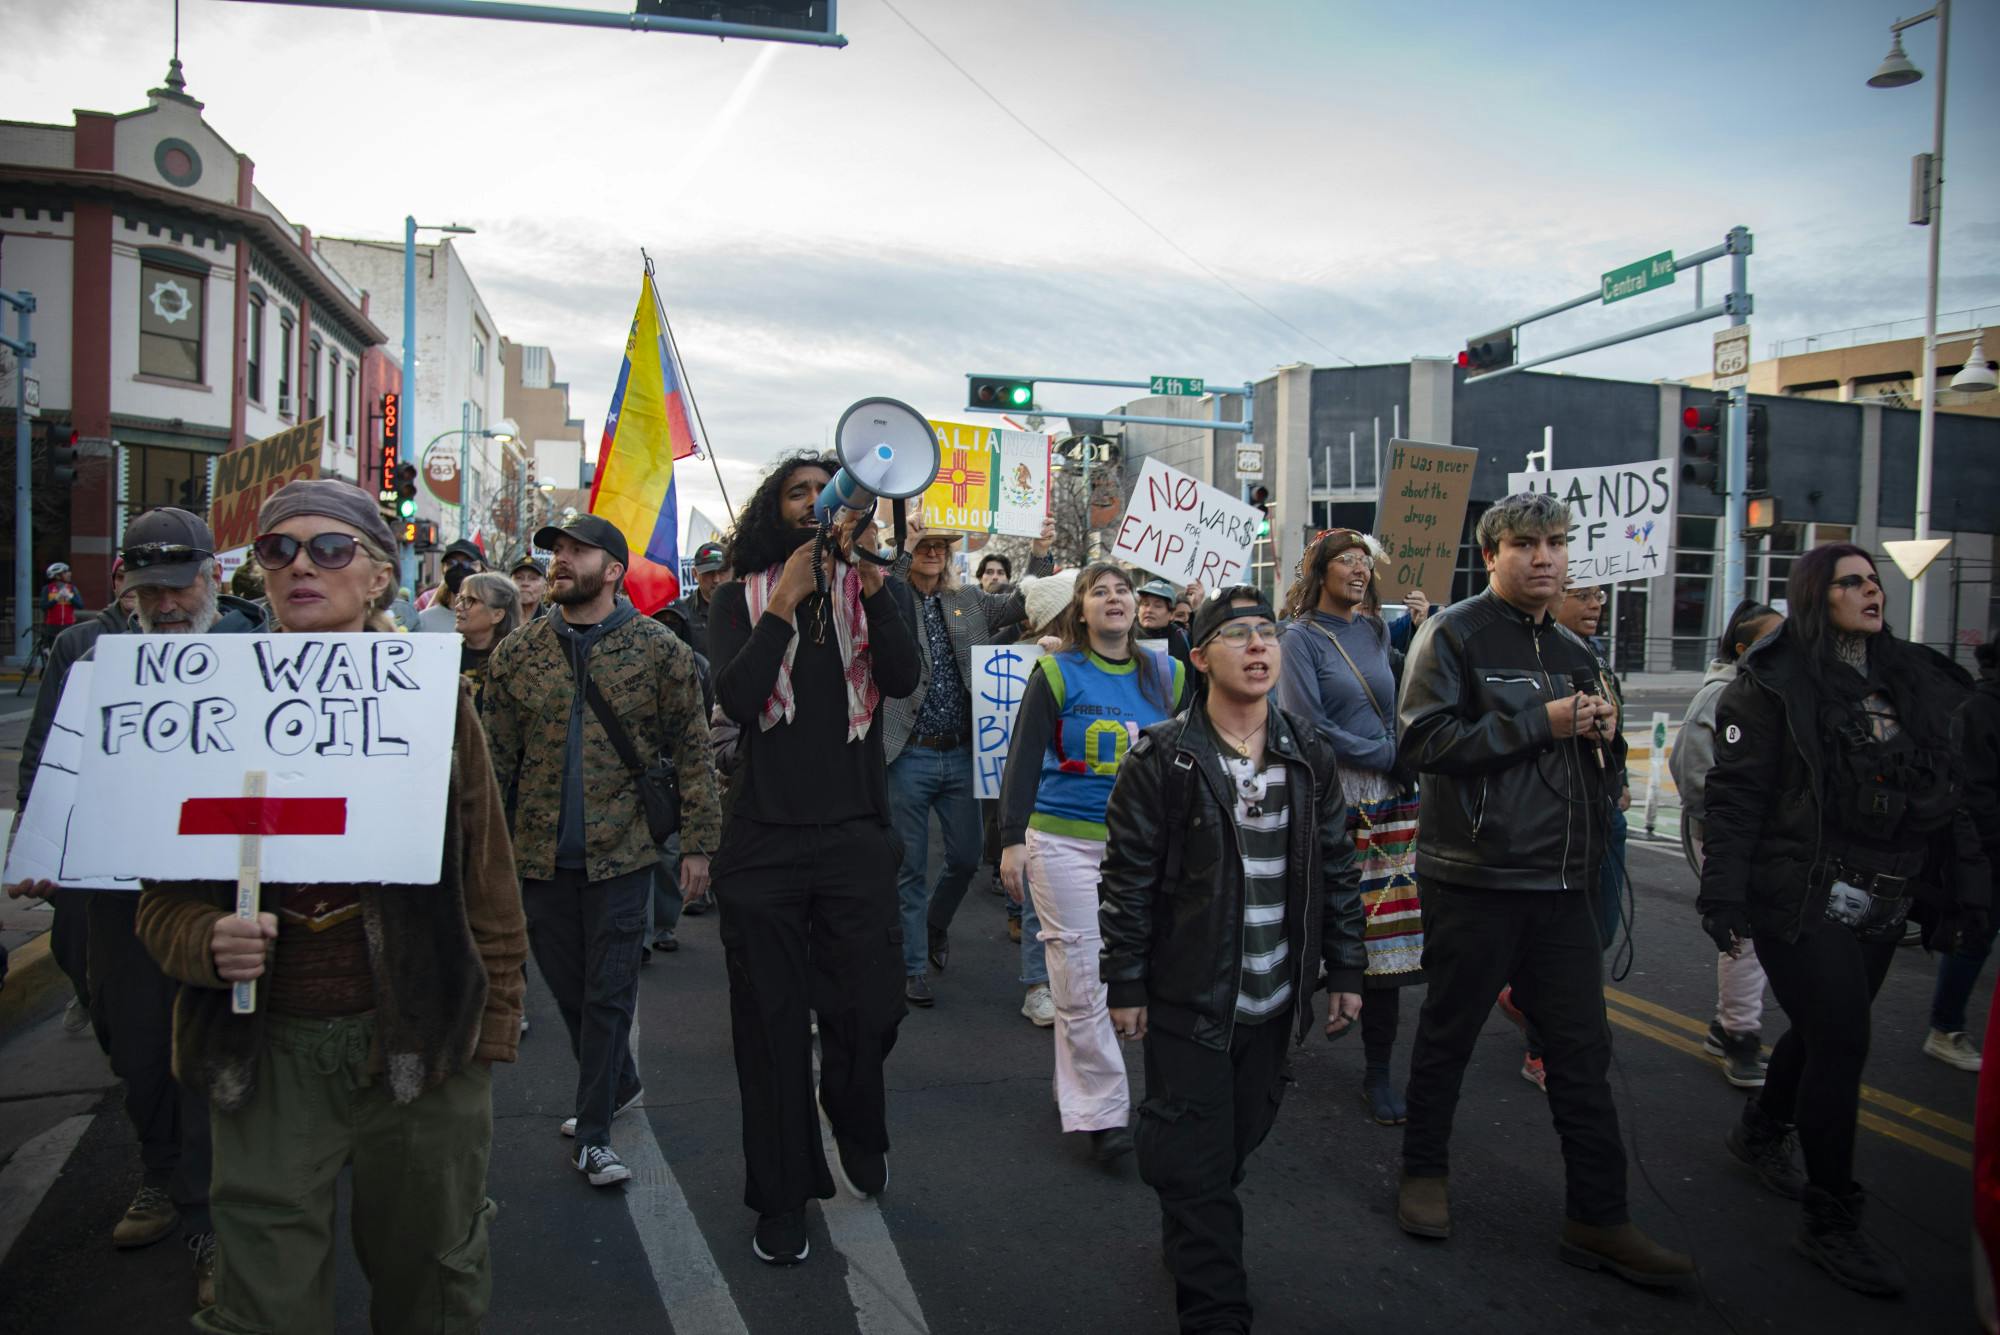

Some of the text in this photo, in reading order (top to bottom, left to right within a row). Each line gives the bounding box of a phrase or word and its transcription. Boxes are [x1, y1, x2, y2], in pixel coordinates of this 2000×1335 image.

[1602, 258, 1673, 300] Central Ave
[1720, 356, 1742, 372] 66
[1152, 379, 1202, 395] 4th St
[384, 395, 396, 488] POOL HALL
[216, 422, 322, 498] NO MORE
[1391, 447, 1469, 474] It was never
[1401, 480, 1448, 499] about the
[1184, 523, 1201, 537] FOR
[1404, 504, 1437, 532] drugs
[405, 523, 416, 541] 2
[1398, 537, 1431, 559] about
[1436, 541, 1452, 558] the
[1397, 562, 1425, 588] Oil
[1567, 545, 1659, 580] EZUELA
[136, 642, 219, 686] NO
[253, 640, 421, 693] WAR
[1073, 704, 1103, 716] FREE
[1107, 706, 1122, 716] TO
[102, 697, 238, 757] FOR
[265, 697, 410, 757] OIL
[1055, 719, 1140, 775] LO
